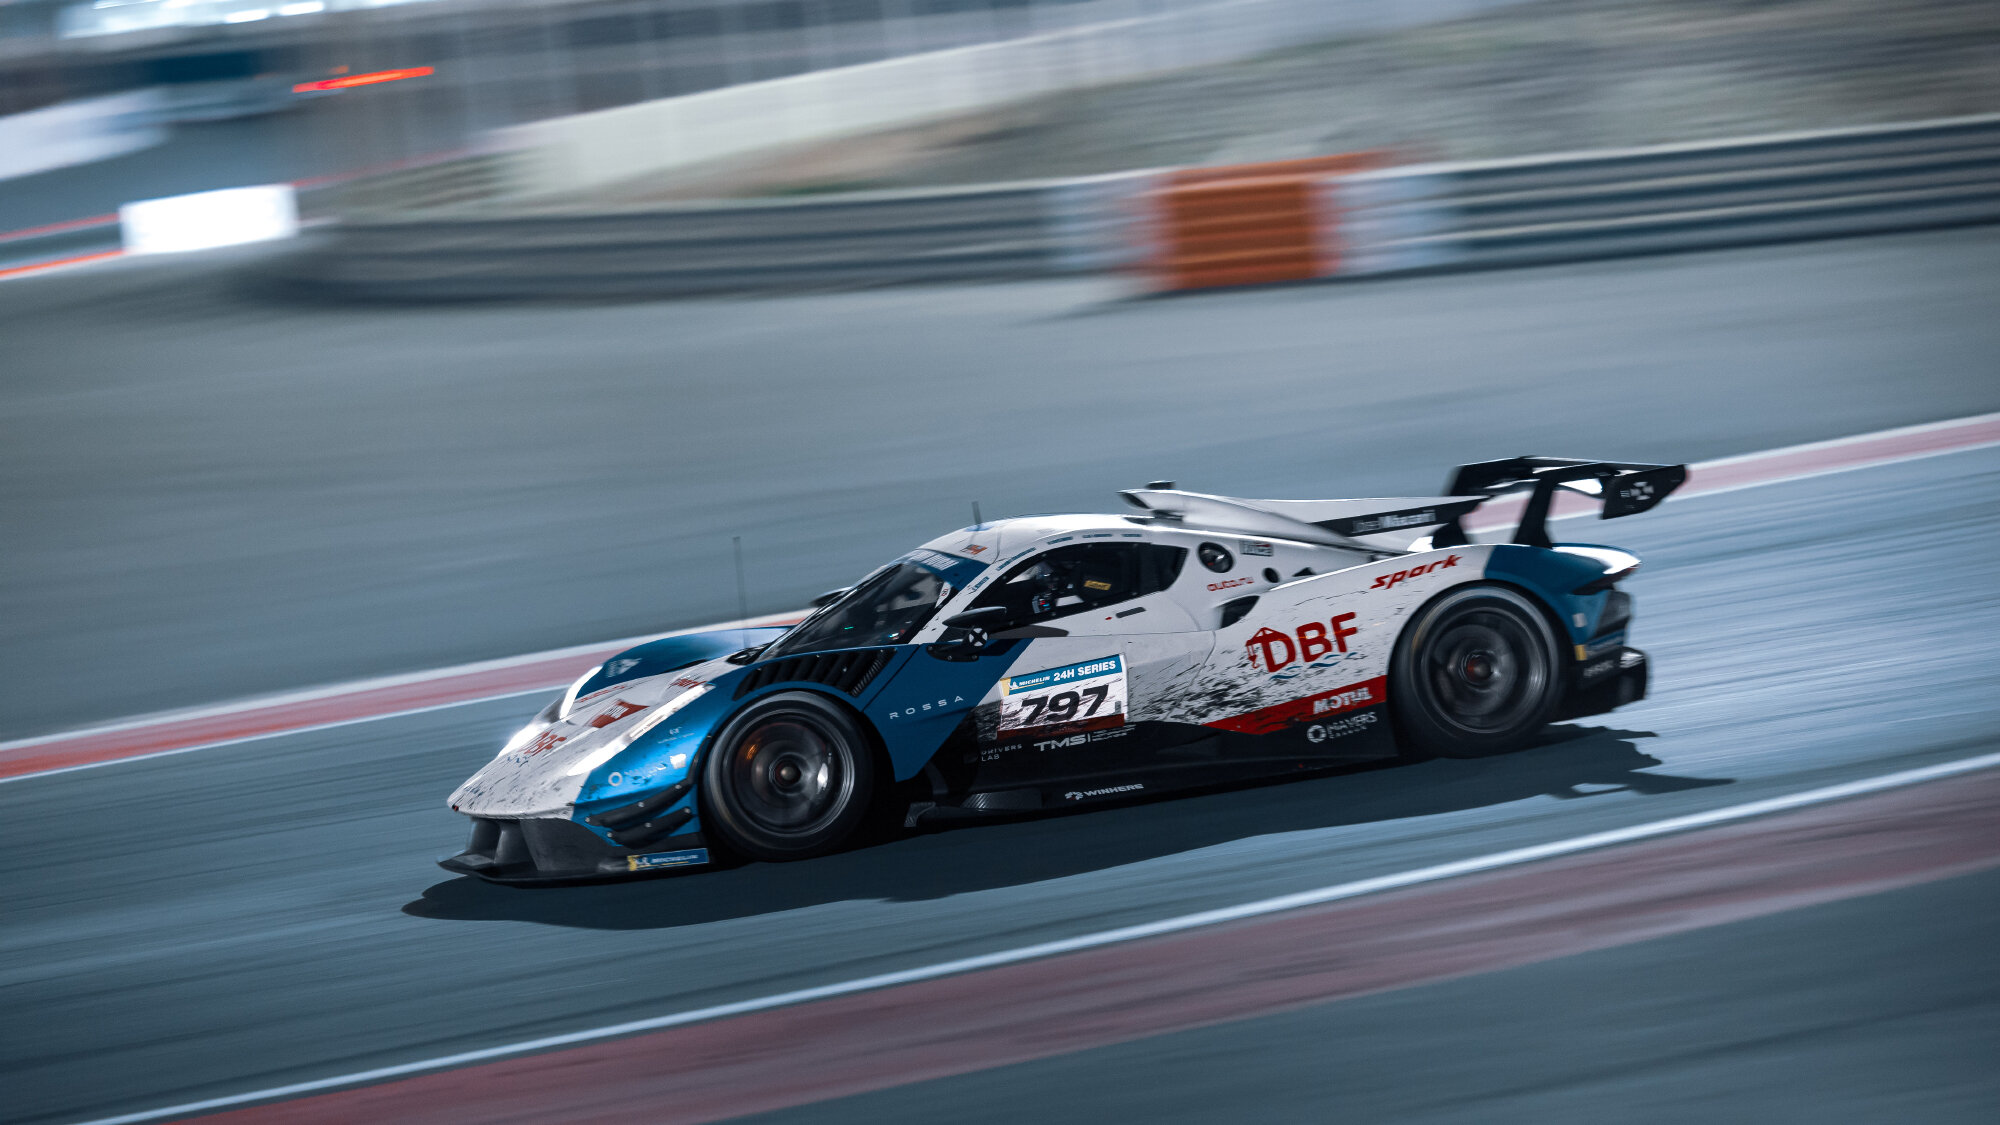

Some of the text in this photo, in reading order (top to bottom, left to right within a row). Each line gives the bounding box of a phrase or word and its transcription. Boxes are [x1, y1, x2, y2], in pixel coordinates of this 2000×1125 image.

[1370, 554, 1463, 590] spark
[1246, 611, 1359, 674] DBF
[1018, 660, 1116, 687] MICHELIN 24H SERIES
[889, 695, 964, 720] ROSSA
[1021, 684, 1109, 726] 797
[1313, 687, 1374, 715] MOTUL
[981, 753, 1000, 762] LAB
